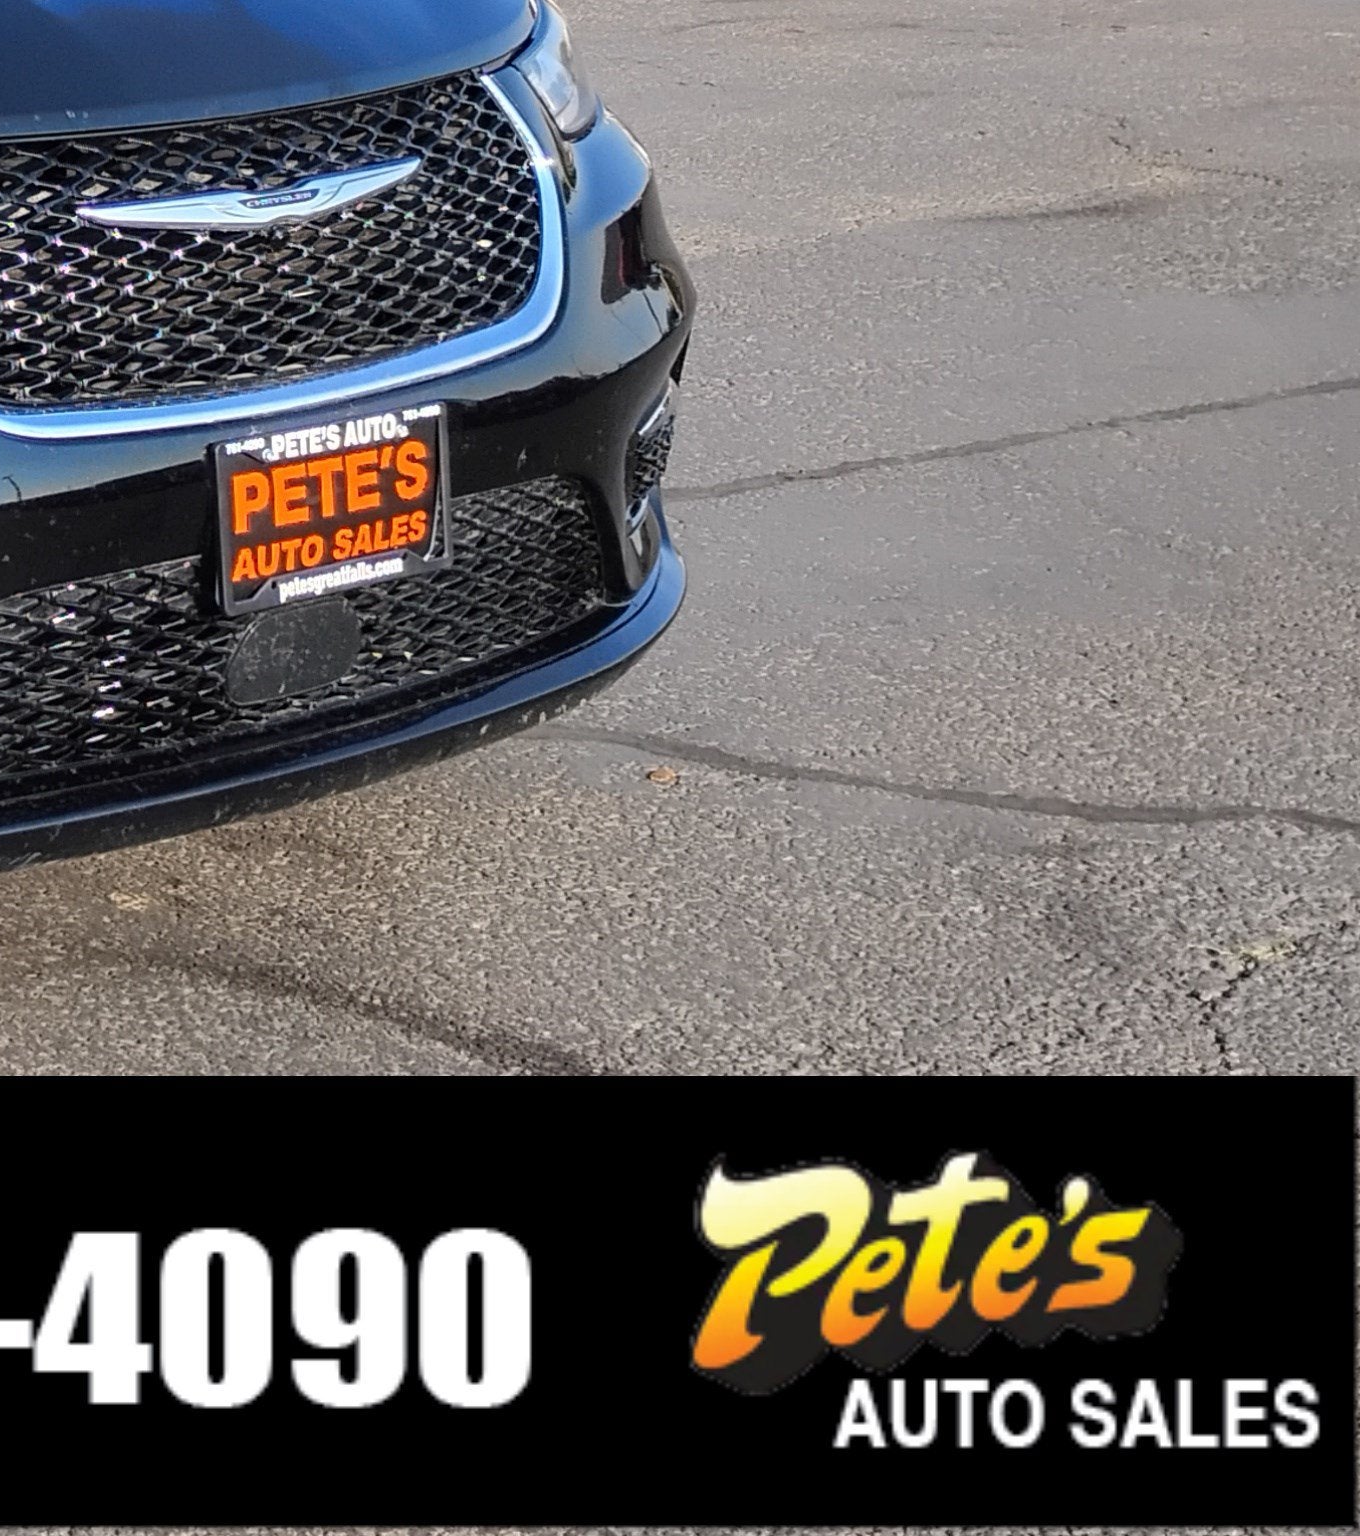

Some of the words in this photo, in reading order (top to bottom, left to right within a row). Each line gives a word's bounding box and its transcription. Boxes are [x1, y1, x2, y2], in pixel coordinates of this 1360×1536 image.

[246, 191, 312, 208] CHRYSLER
[270, 423, 342, 461] PETE'S
[343, 413, 396, 449] AUTO
[231, 439, 429, 536] PETE'S
[231, 534, 325, 584] AUTO
[333, 510, 428, 562] SALES
[279, 557, 404, 604] petesgreatfalls.com
